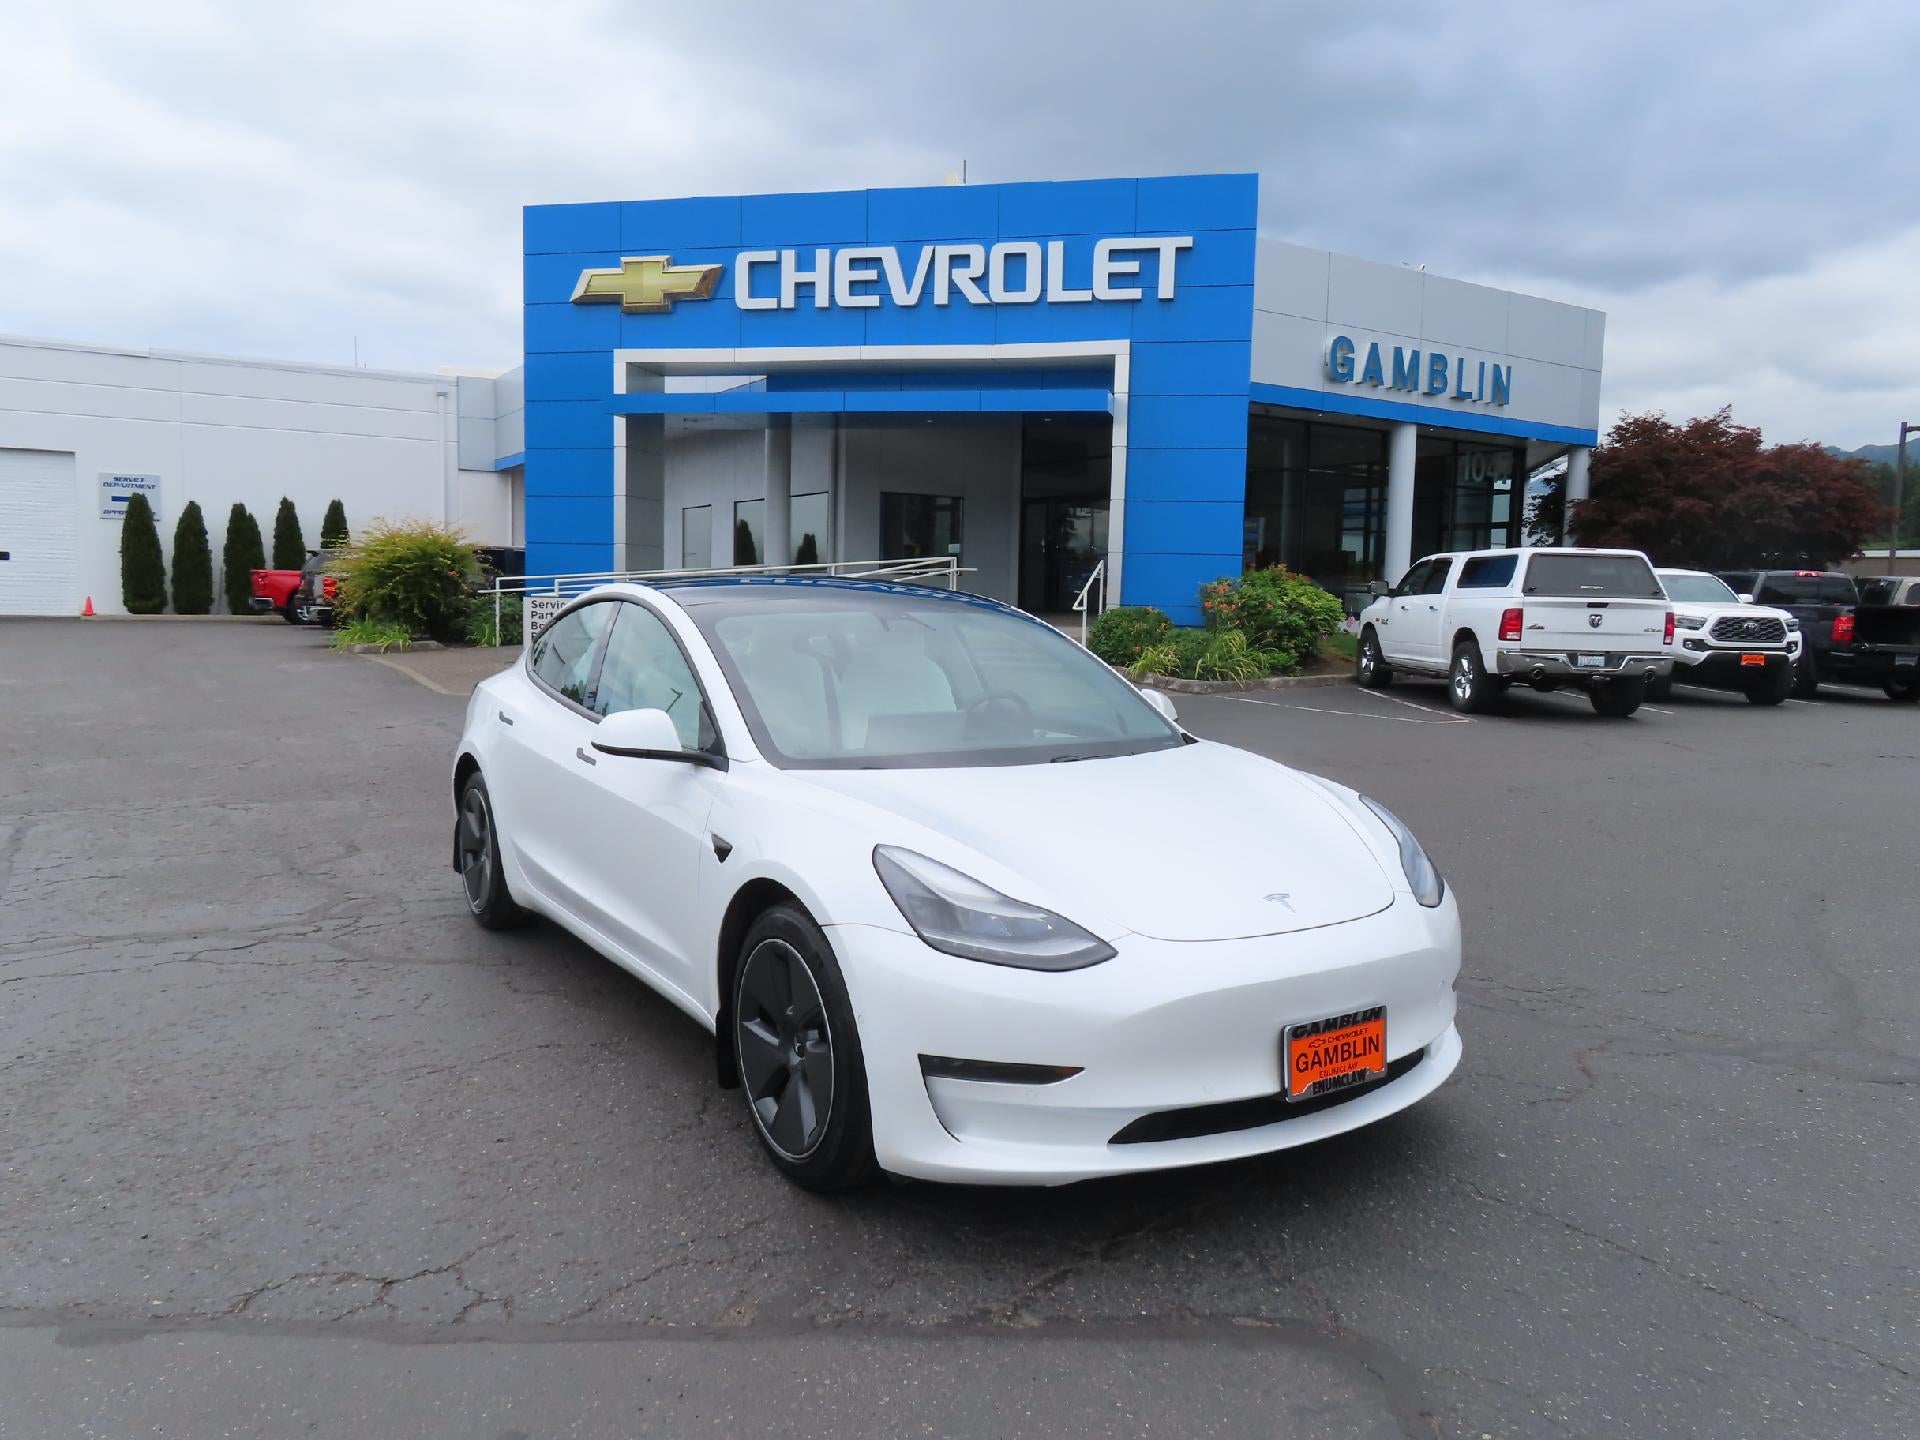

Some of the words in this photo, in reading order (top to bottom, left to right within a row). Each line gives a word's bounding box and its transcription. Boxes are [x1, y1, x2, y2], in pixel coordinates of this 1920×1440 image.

[734, 236, 1194, 310] CHEVROLET
[1330, 335, 1512, 405] GAMBLIN
[1291, 1006, 1383, 1039] GAMBLIN
[1327, 1027, 1369, 1044] CHEVROLET
[1295, 1034, 1380, 1074] GAMBLIN
[1319, 1062, 1358, 1079] ENUMCLAW
[1312, 1068, 1368, 1095] ENUMCLAW
